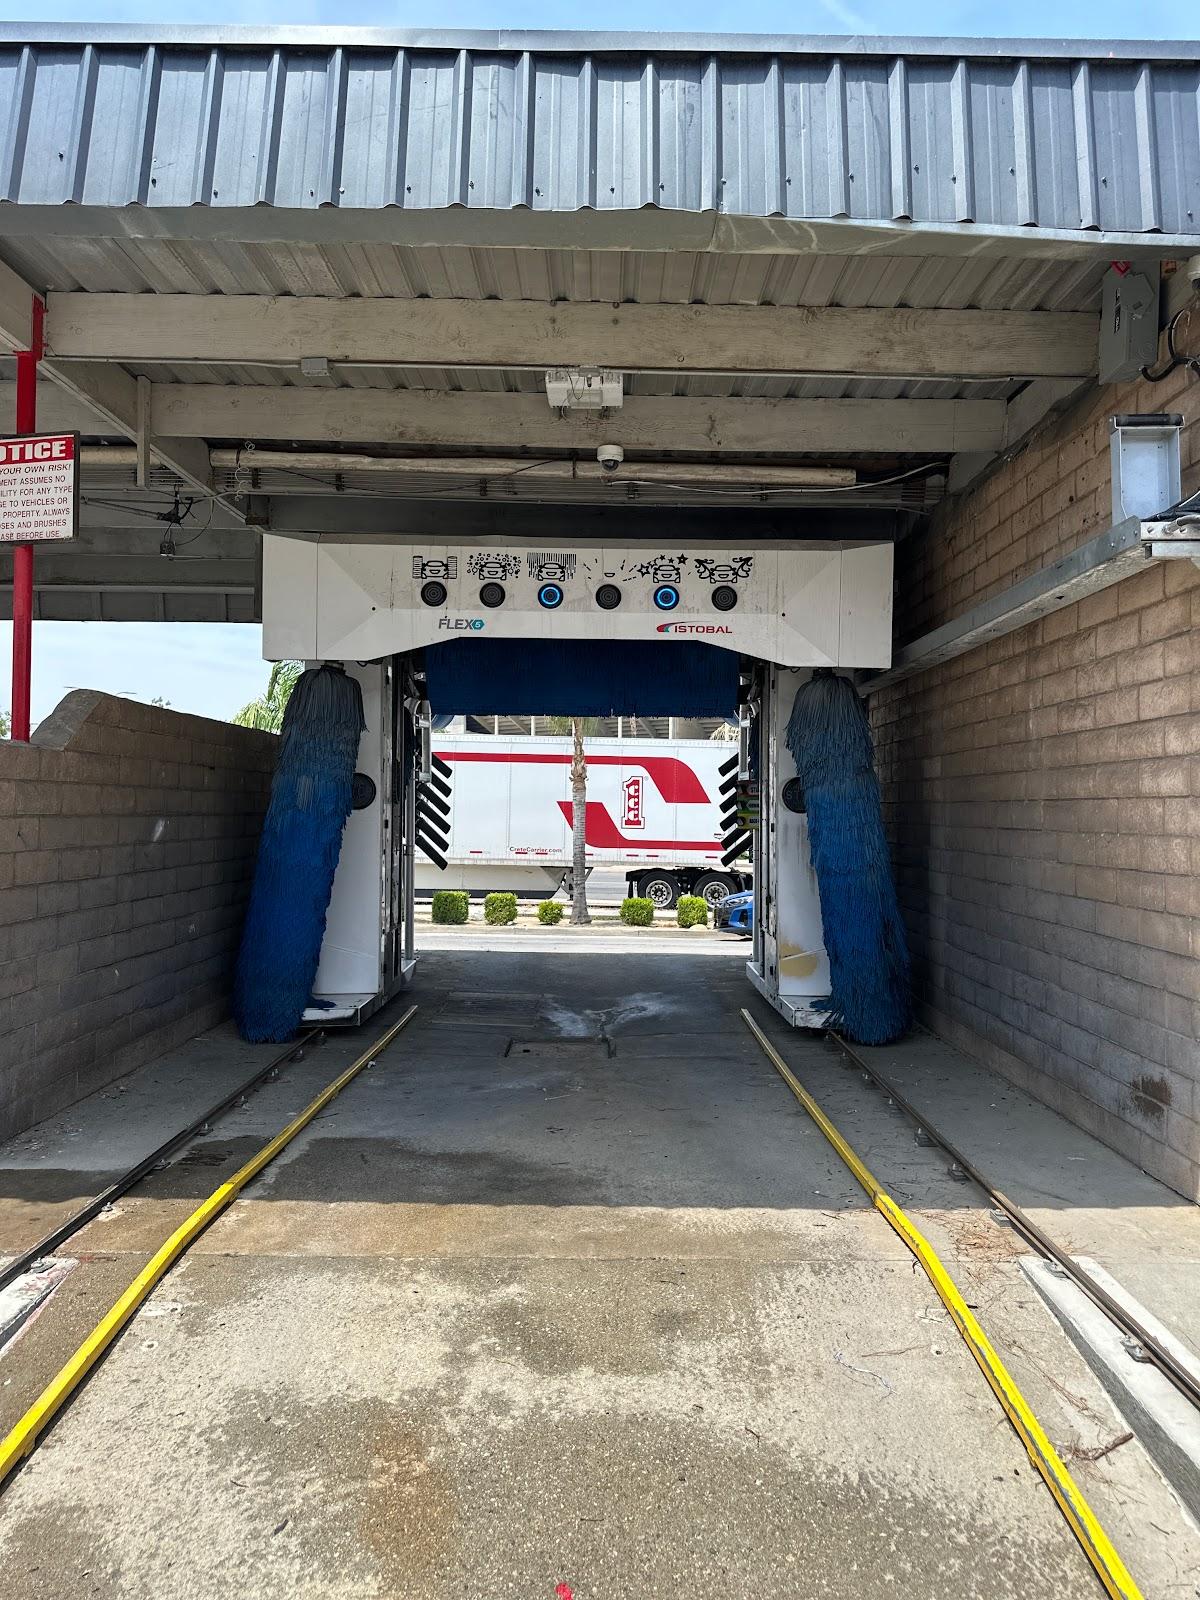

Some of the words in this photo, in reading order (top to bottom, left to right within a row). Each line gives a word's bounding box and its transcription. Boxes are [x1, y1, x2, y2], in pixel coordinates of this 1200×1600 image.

[24, 465, 45, 473] OWN
[48, 463, 71, 471] RISK!
[20, 476, 53, 485] ASSUMES
[19, 488, 34, 496] FOR
[37, 487, 51, 495] ANY
[21, 497, 55, 507] VEHICLES
[43, 508, 70, 516] ALWAYS
[34, 519, 67, 527] BRUSHES
[16, 531, 44, 539] BEFORE
[46, 530, 60, 538] USE
[674, 625, 733, 634] ISTOBAL
